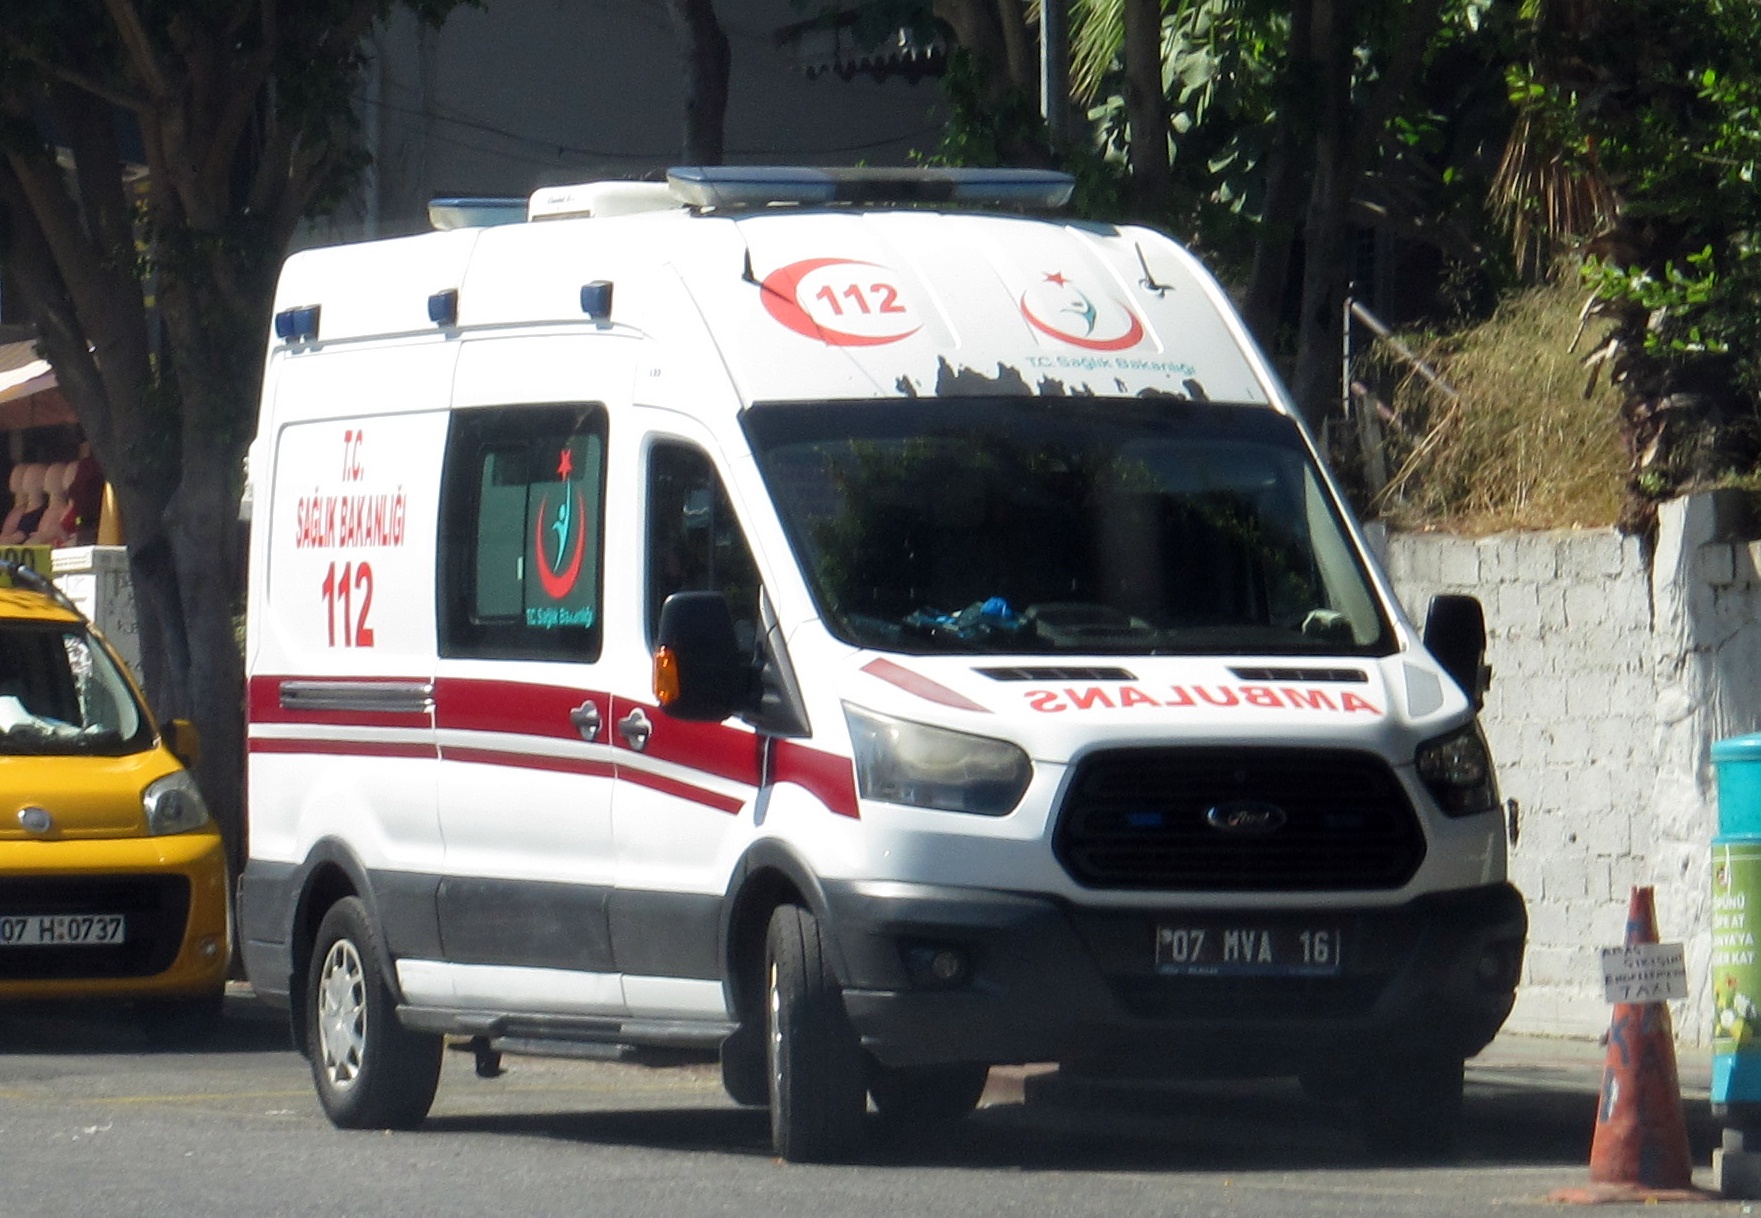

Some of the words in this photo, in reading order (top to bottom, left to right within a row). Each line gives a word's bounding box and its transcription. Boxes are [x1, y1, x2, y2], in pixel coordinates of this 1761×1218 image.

[816, 283, 906, 315] 112
[296, 485, 337, 548] SAĞLIK
[339, 484, 407, 547] BAKANLIĞI
[322, 561, 374, 647] 112
[2, 918, 27, 940] 07
[69, 918, 121, 940] 0737
[1173, 930, 1205, 962] 07
[1224, 930, 1272, 963] MVA
[1300, 931, 1329, 962] 16
